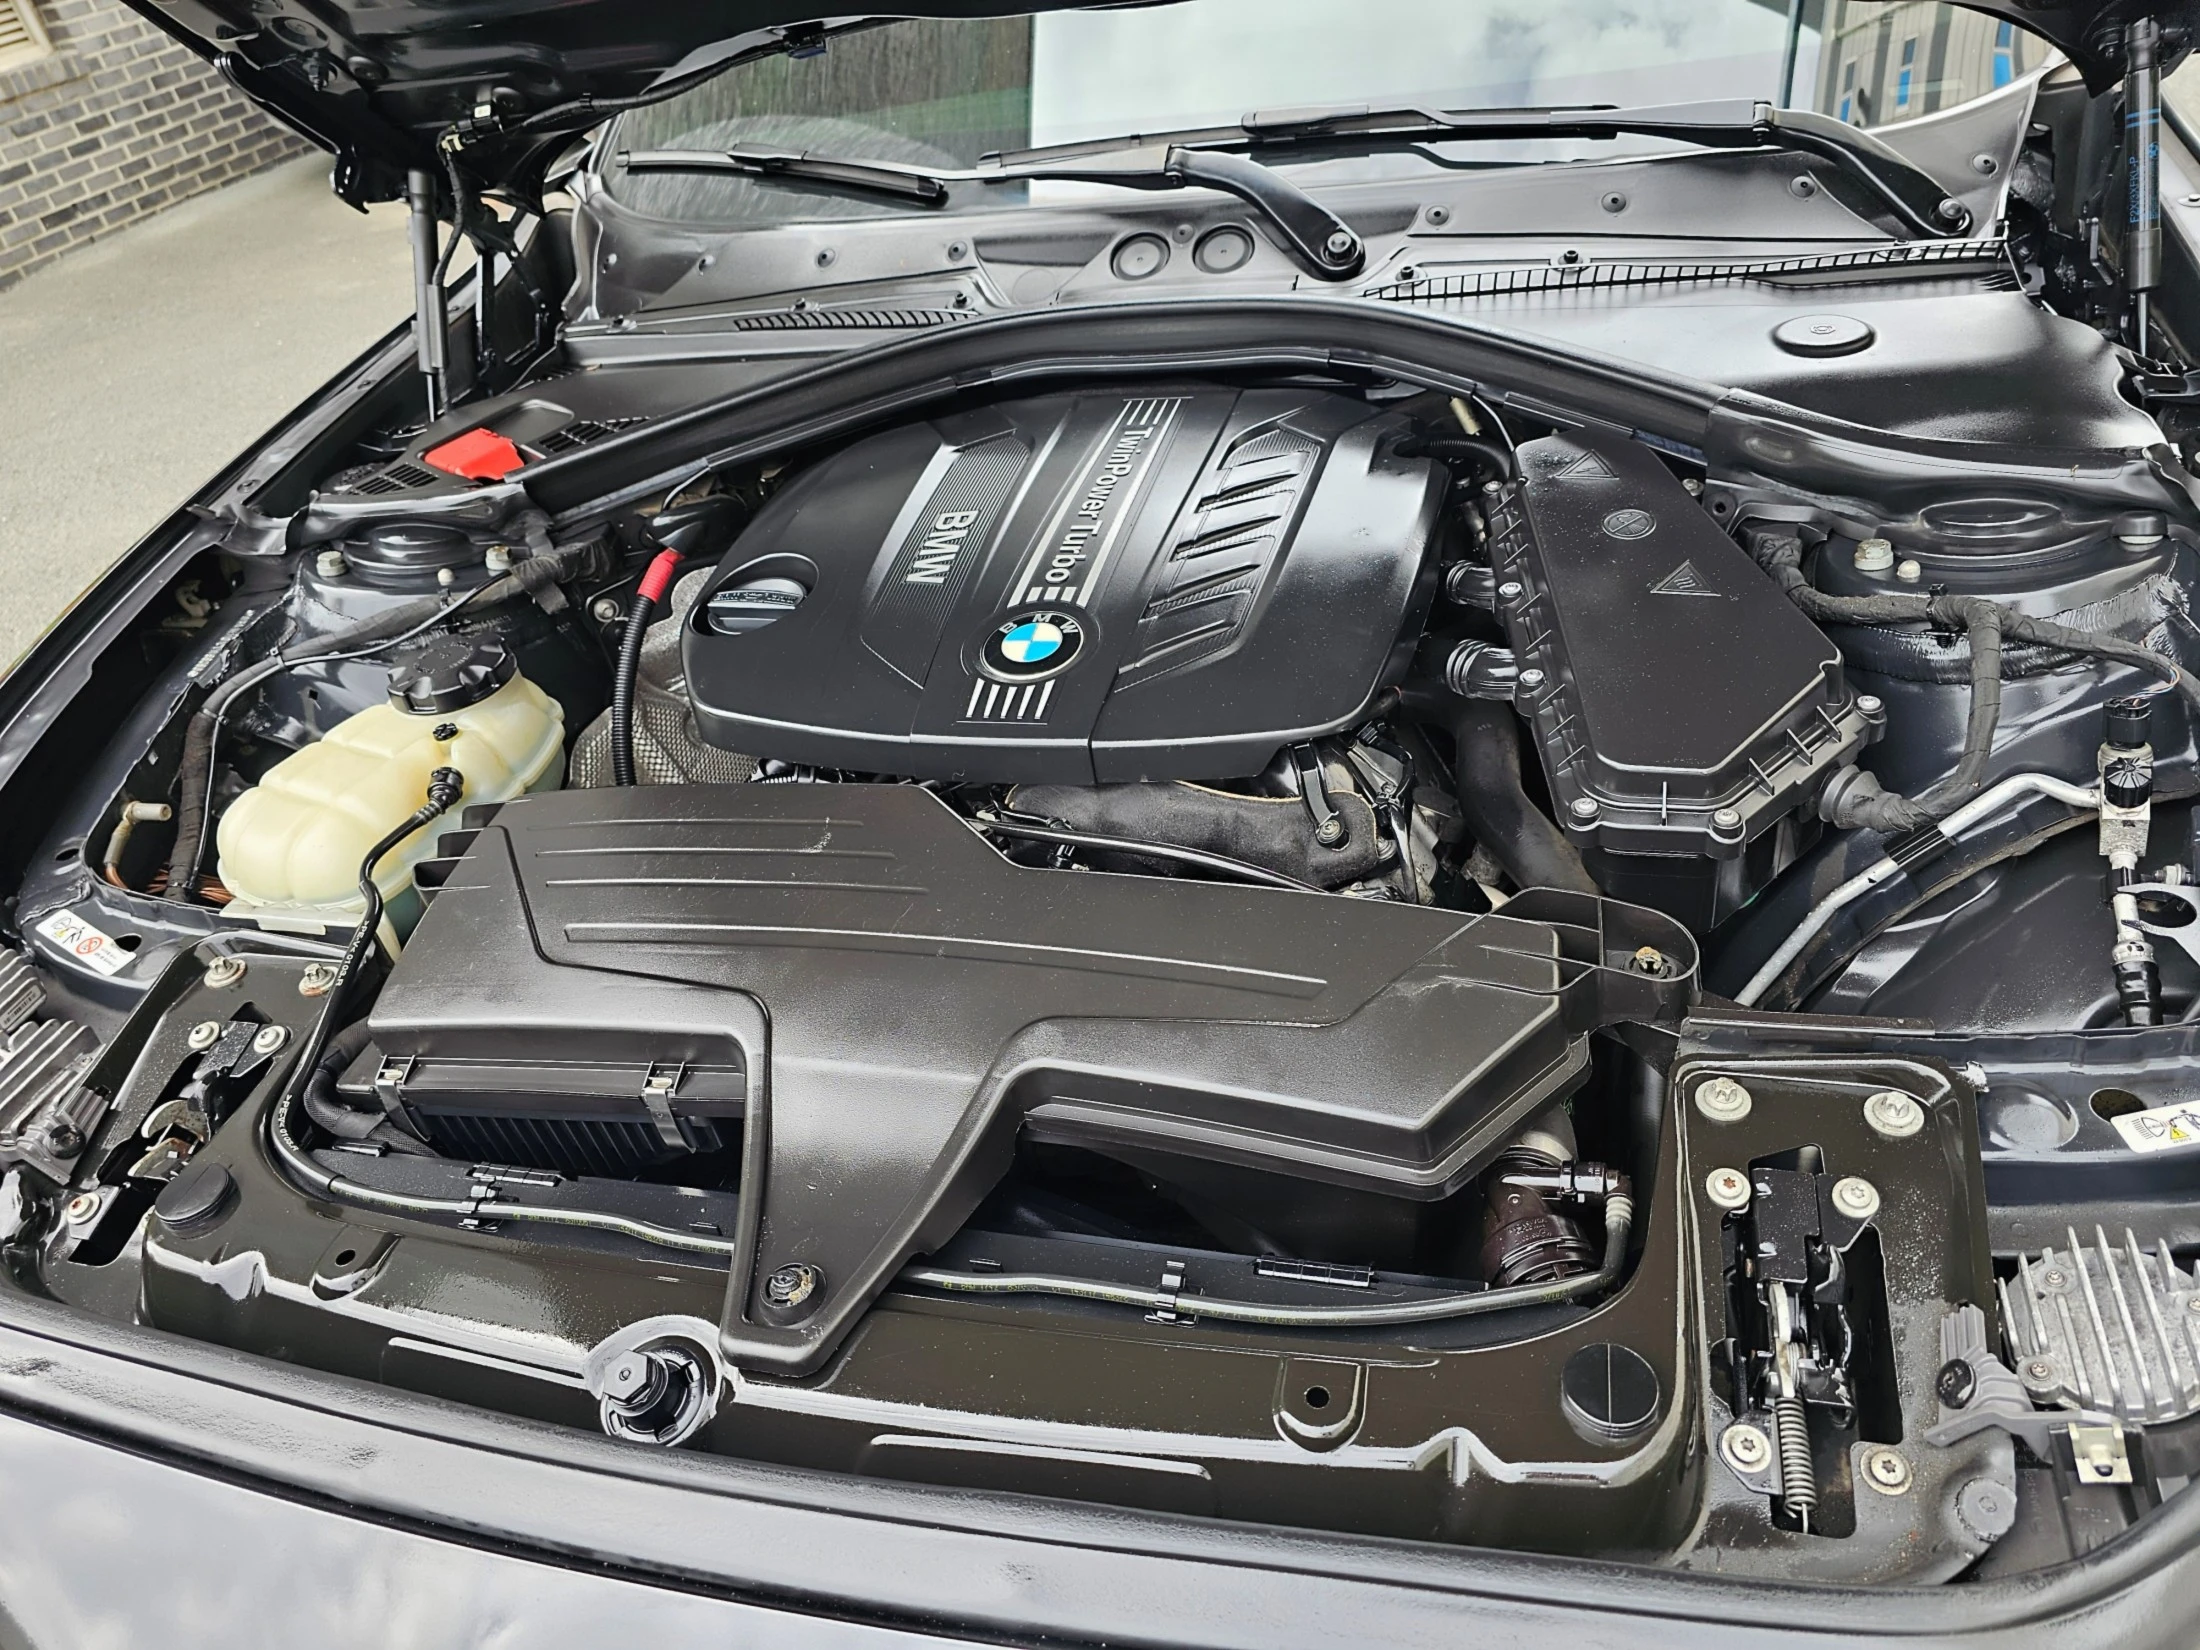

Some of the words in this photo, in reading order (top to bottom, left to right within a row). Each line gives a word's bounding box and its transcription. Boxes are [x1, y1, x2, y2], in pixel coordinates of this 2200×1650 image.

[1078, 427, 1154, 520] TwinPower
[905, 509, 979, 584] BMW
[1045, 520, 1103, 584] Turbo
[999, 613, 1079, 634] BMW
